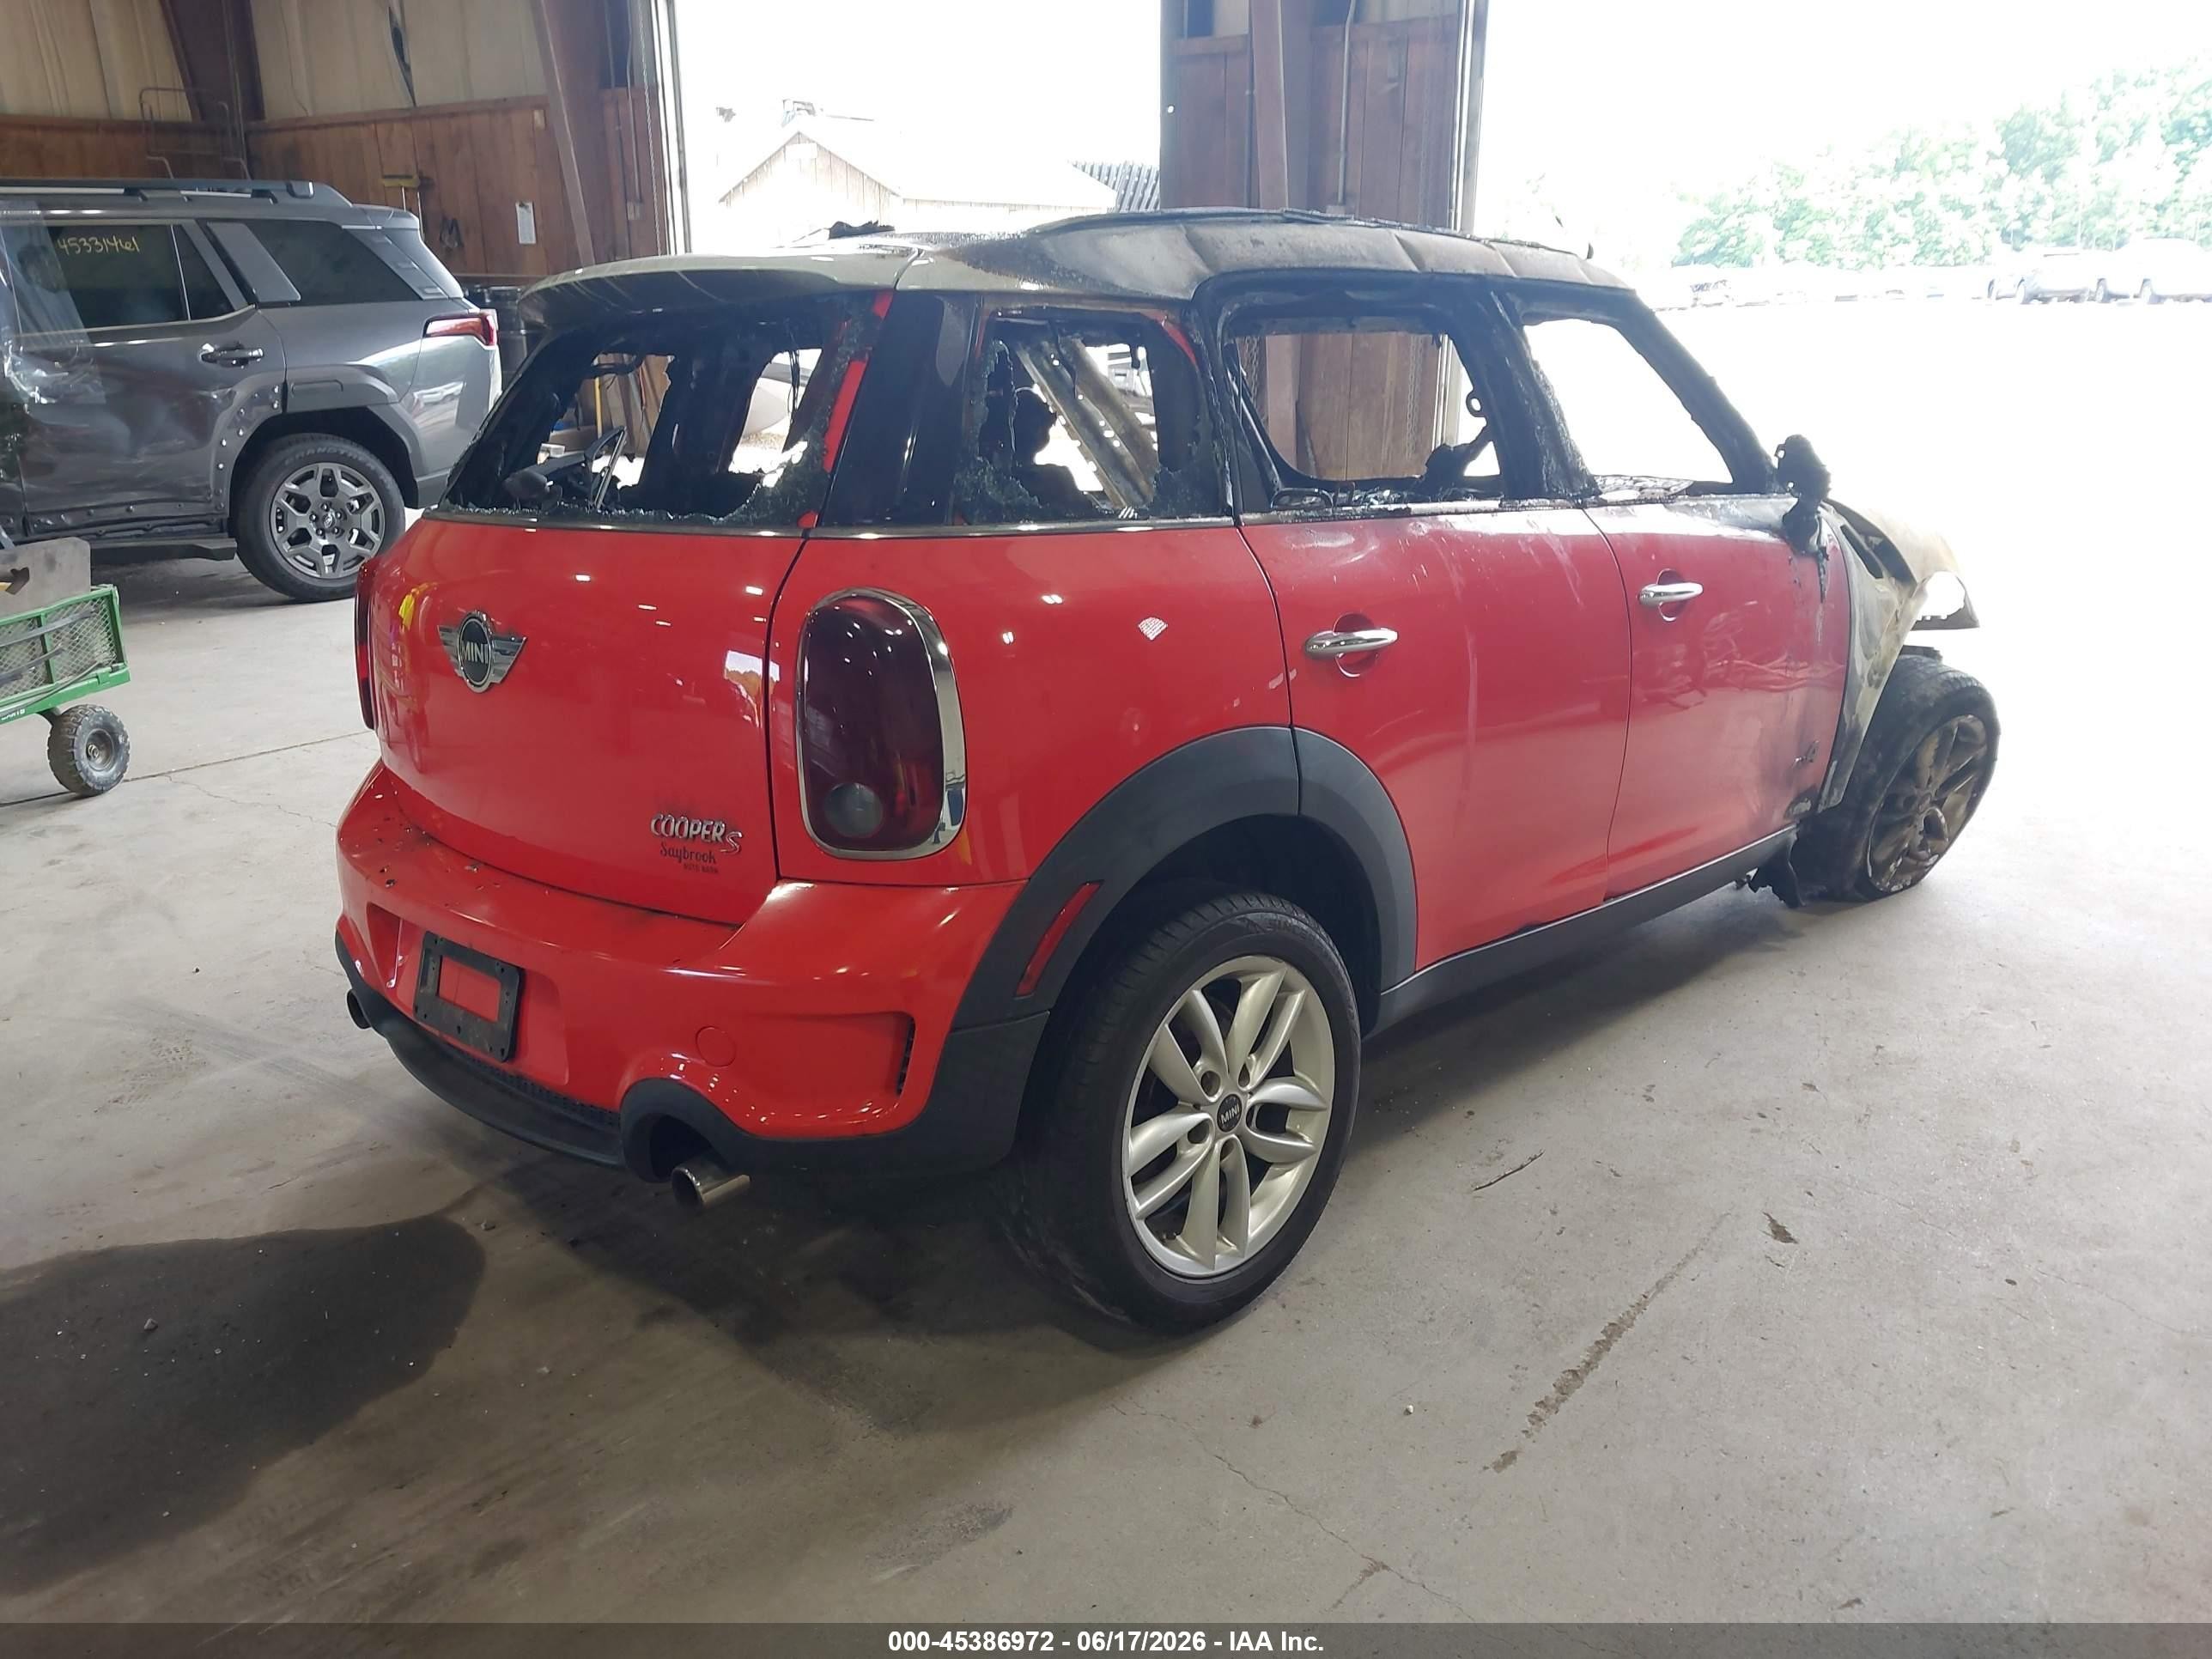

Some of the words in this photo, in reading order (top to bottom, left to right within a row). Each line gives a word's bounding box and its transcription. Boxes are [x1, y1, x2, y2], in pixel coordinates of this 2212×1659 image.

[57, 234, 141, 255] 45331461
[462, 641, 489, 665] MINI
[650, 813, 726, 843] COOPER
[720, 830, 743, 854] S
[659, 841, 717, 864] Saybrook
[1220, 1103, 1240, 1125] MINI
